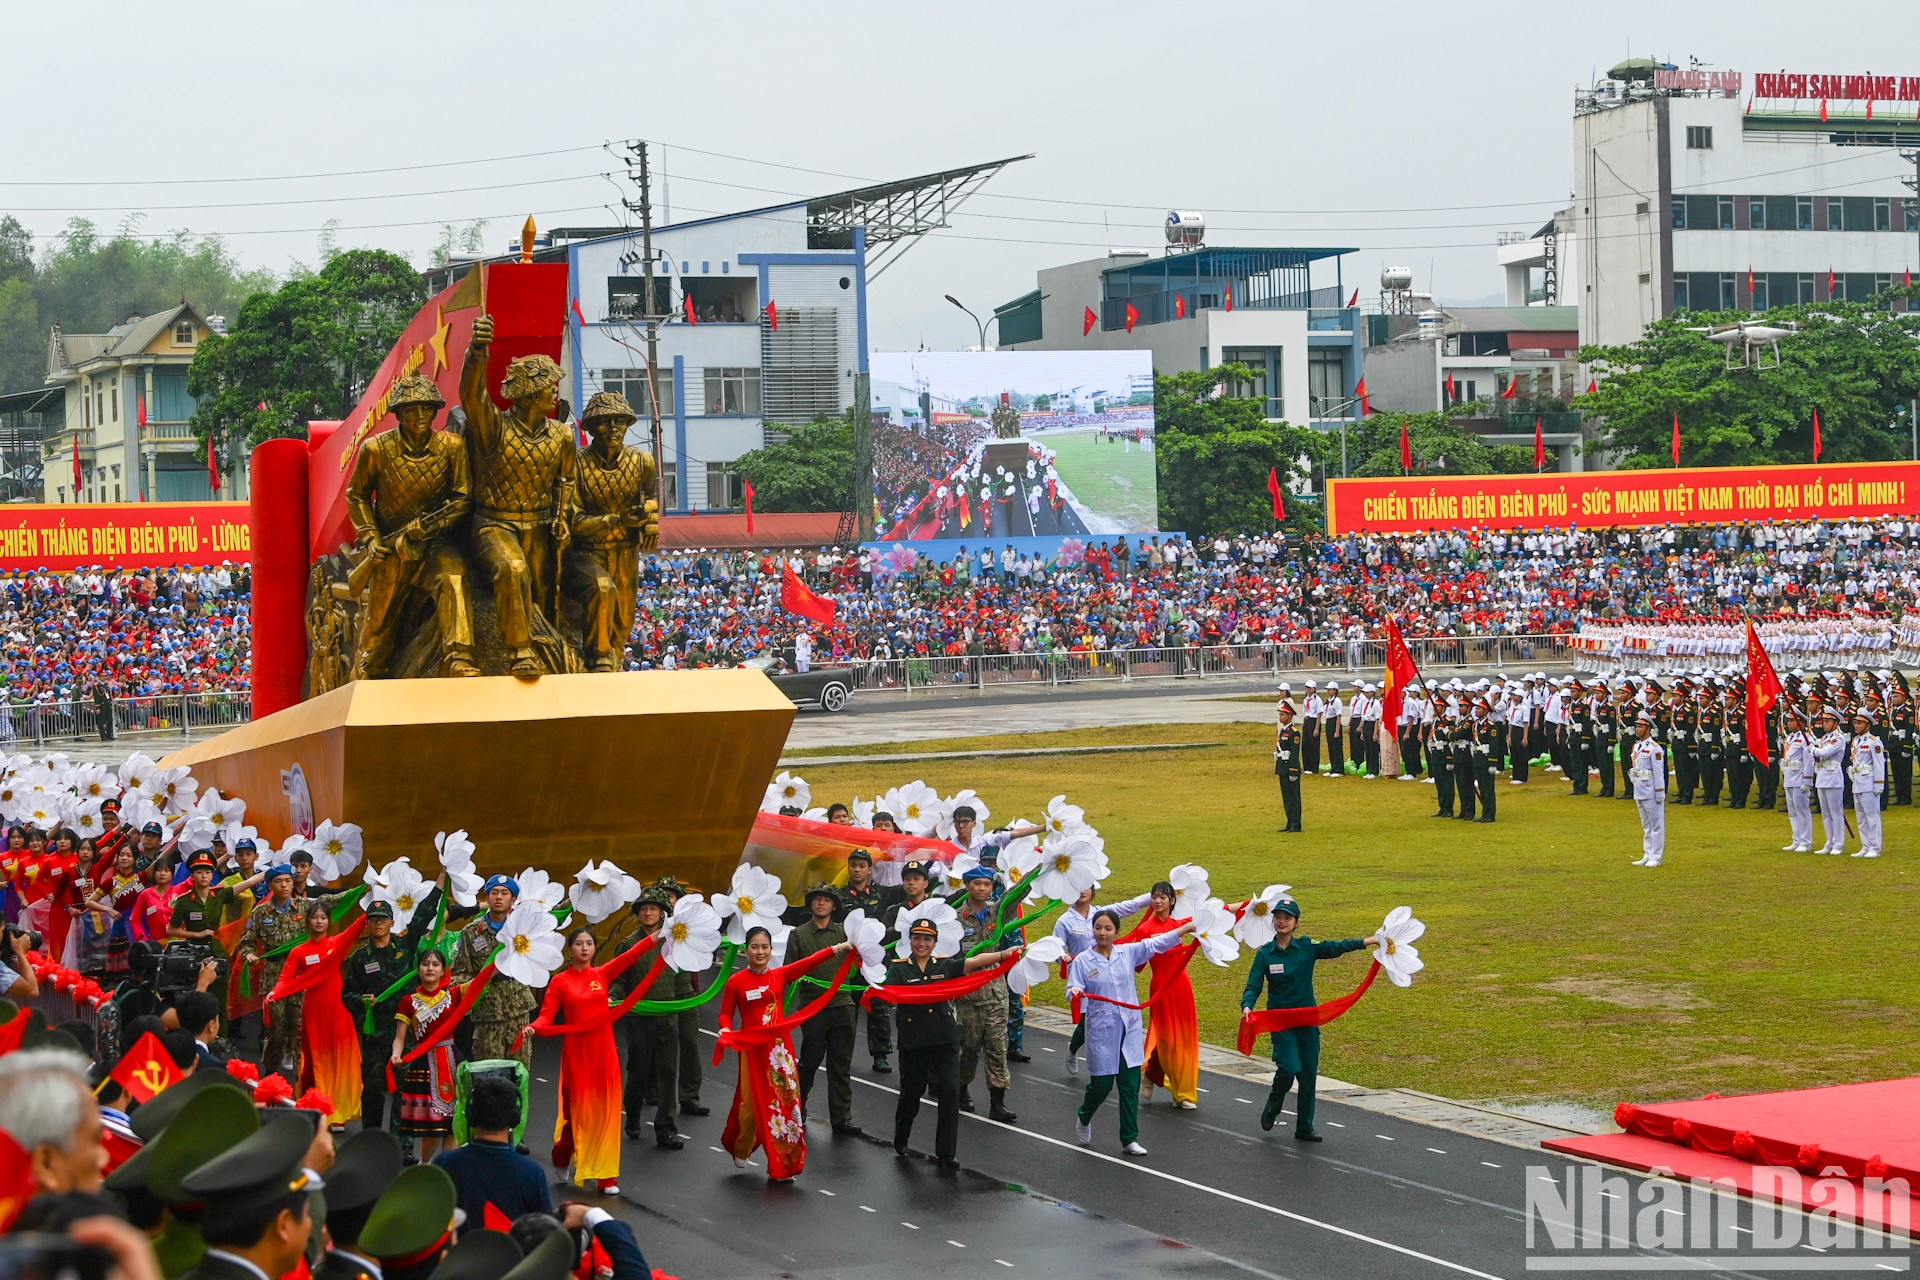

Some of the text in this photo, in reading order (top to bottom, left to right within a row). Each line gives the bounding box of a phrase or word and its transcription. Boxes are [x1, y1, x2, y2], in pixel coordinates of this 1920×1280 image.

[1710, 71, 1742, 91] ANH
[1755, 69, 1807, 98] KHÁCH
[1845, 71, 1896, 100] HOÀNG
[1364, 490, 1407, 521] CHIẾN
[1410, 488, 1458, 520] THẮNG
[1462, 490, 1496, 524] ĐIỆN
[1500, 489, 1534, 518] BIÊN
[1538, 486, 1568, 516] PHỦ
[1581, 487, 1611, 515] SỨC
[1615, 490, 1660, 518] MẠNH
[1663, 483, 1694, 517] VIỆT
[1698, 486, 1733, 510] NAM
[1737, 480, 1770, 509] THỜI
[1774, 484, 1799, 513] ĐẠI
[1803, 476, 1824, 507] HỒ
[1828, 478, 1854, 506] CHÍ
[41, 517, 88, 557] THẮNG
[92, 521, 127, 561] ĐIỆN
[130, 521, 165, 554] BIÊN
[168, 516, 198, 554] PHỦ
[211, 518, 250, 551] LỪNG
